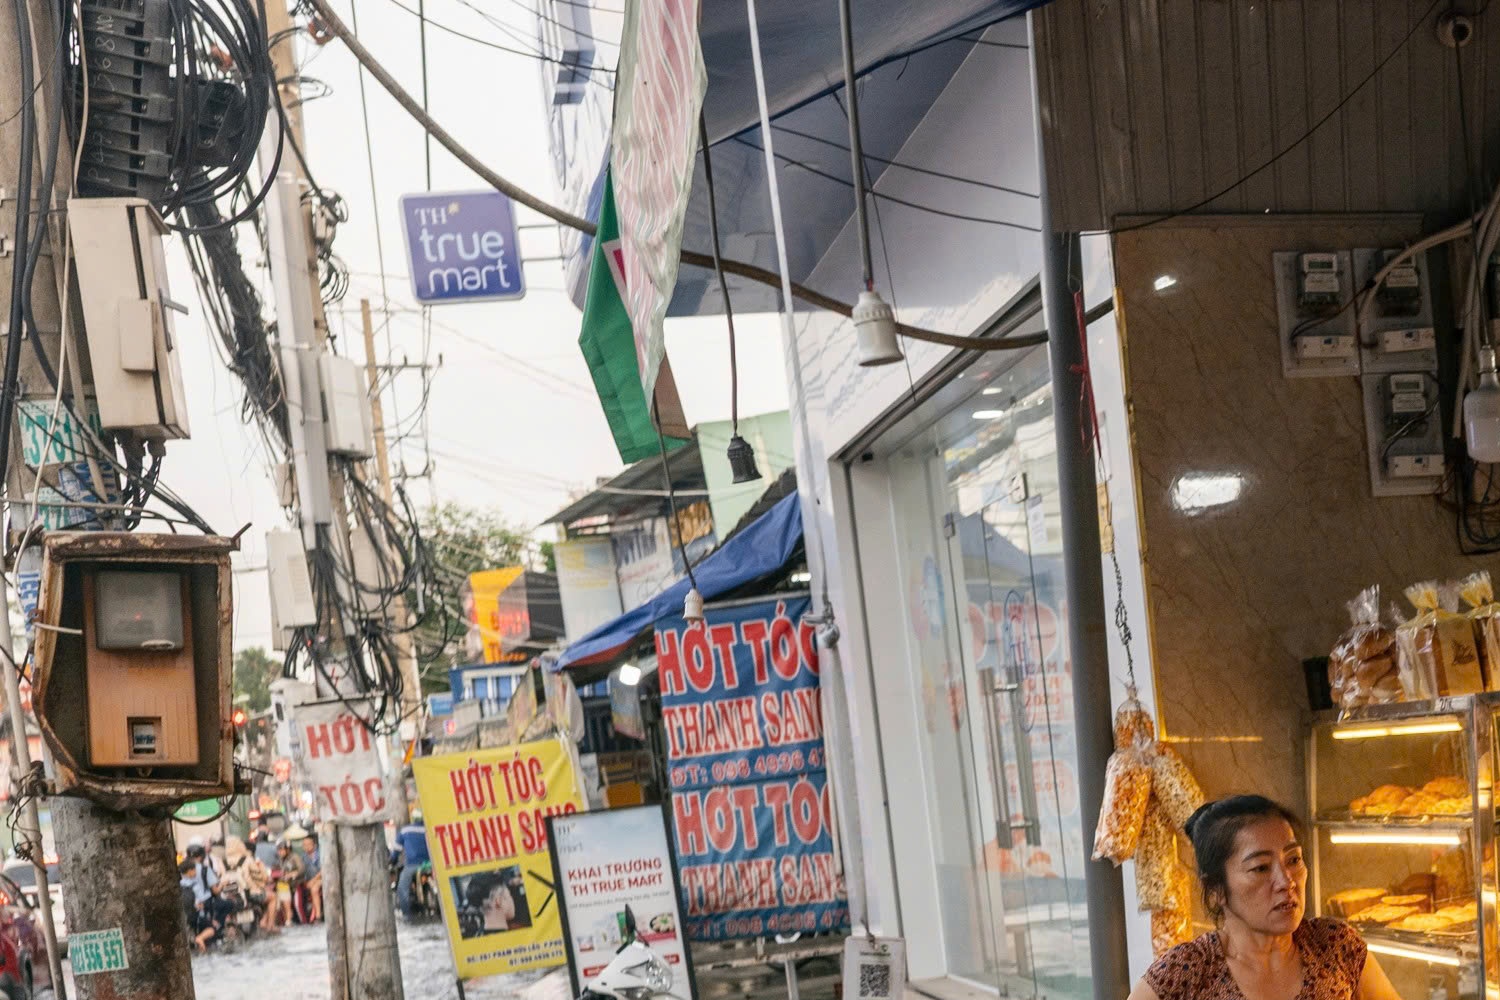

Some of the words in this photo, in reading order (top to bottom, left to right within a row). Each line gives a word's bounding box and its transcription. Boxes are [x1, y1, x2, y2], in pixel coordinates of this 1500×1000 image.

[414, 207, 447, 225] TH
[418, 227, 505, 262] true
[428, 258, 511, 293] mart
[662, 696, 764, 759] THANH
[319, 773, 386, 817] TÓC
[450, 757, 497, 813] HỚT
[498, 751, 547, 805] TÓC
[434, 813, 518, 869] THANH
[518, 802, 577, 855] SA
[567, 864, 601, 882] KHAI
[571, 882, 588, 897] TH
[592, 877, 626, 894] TRUE
[628, 871, 665, 889] MART
[681, 857, 779, 917] THANH
